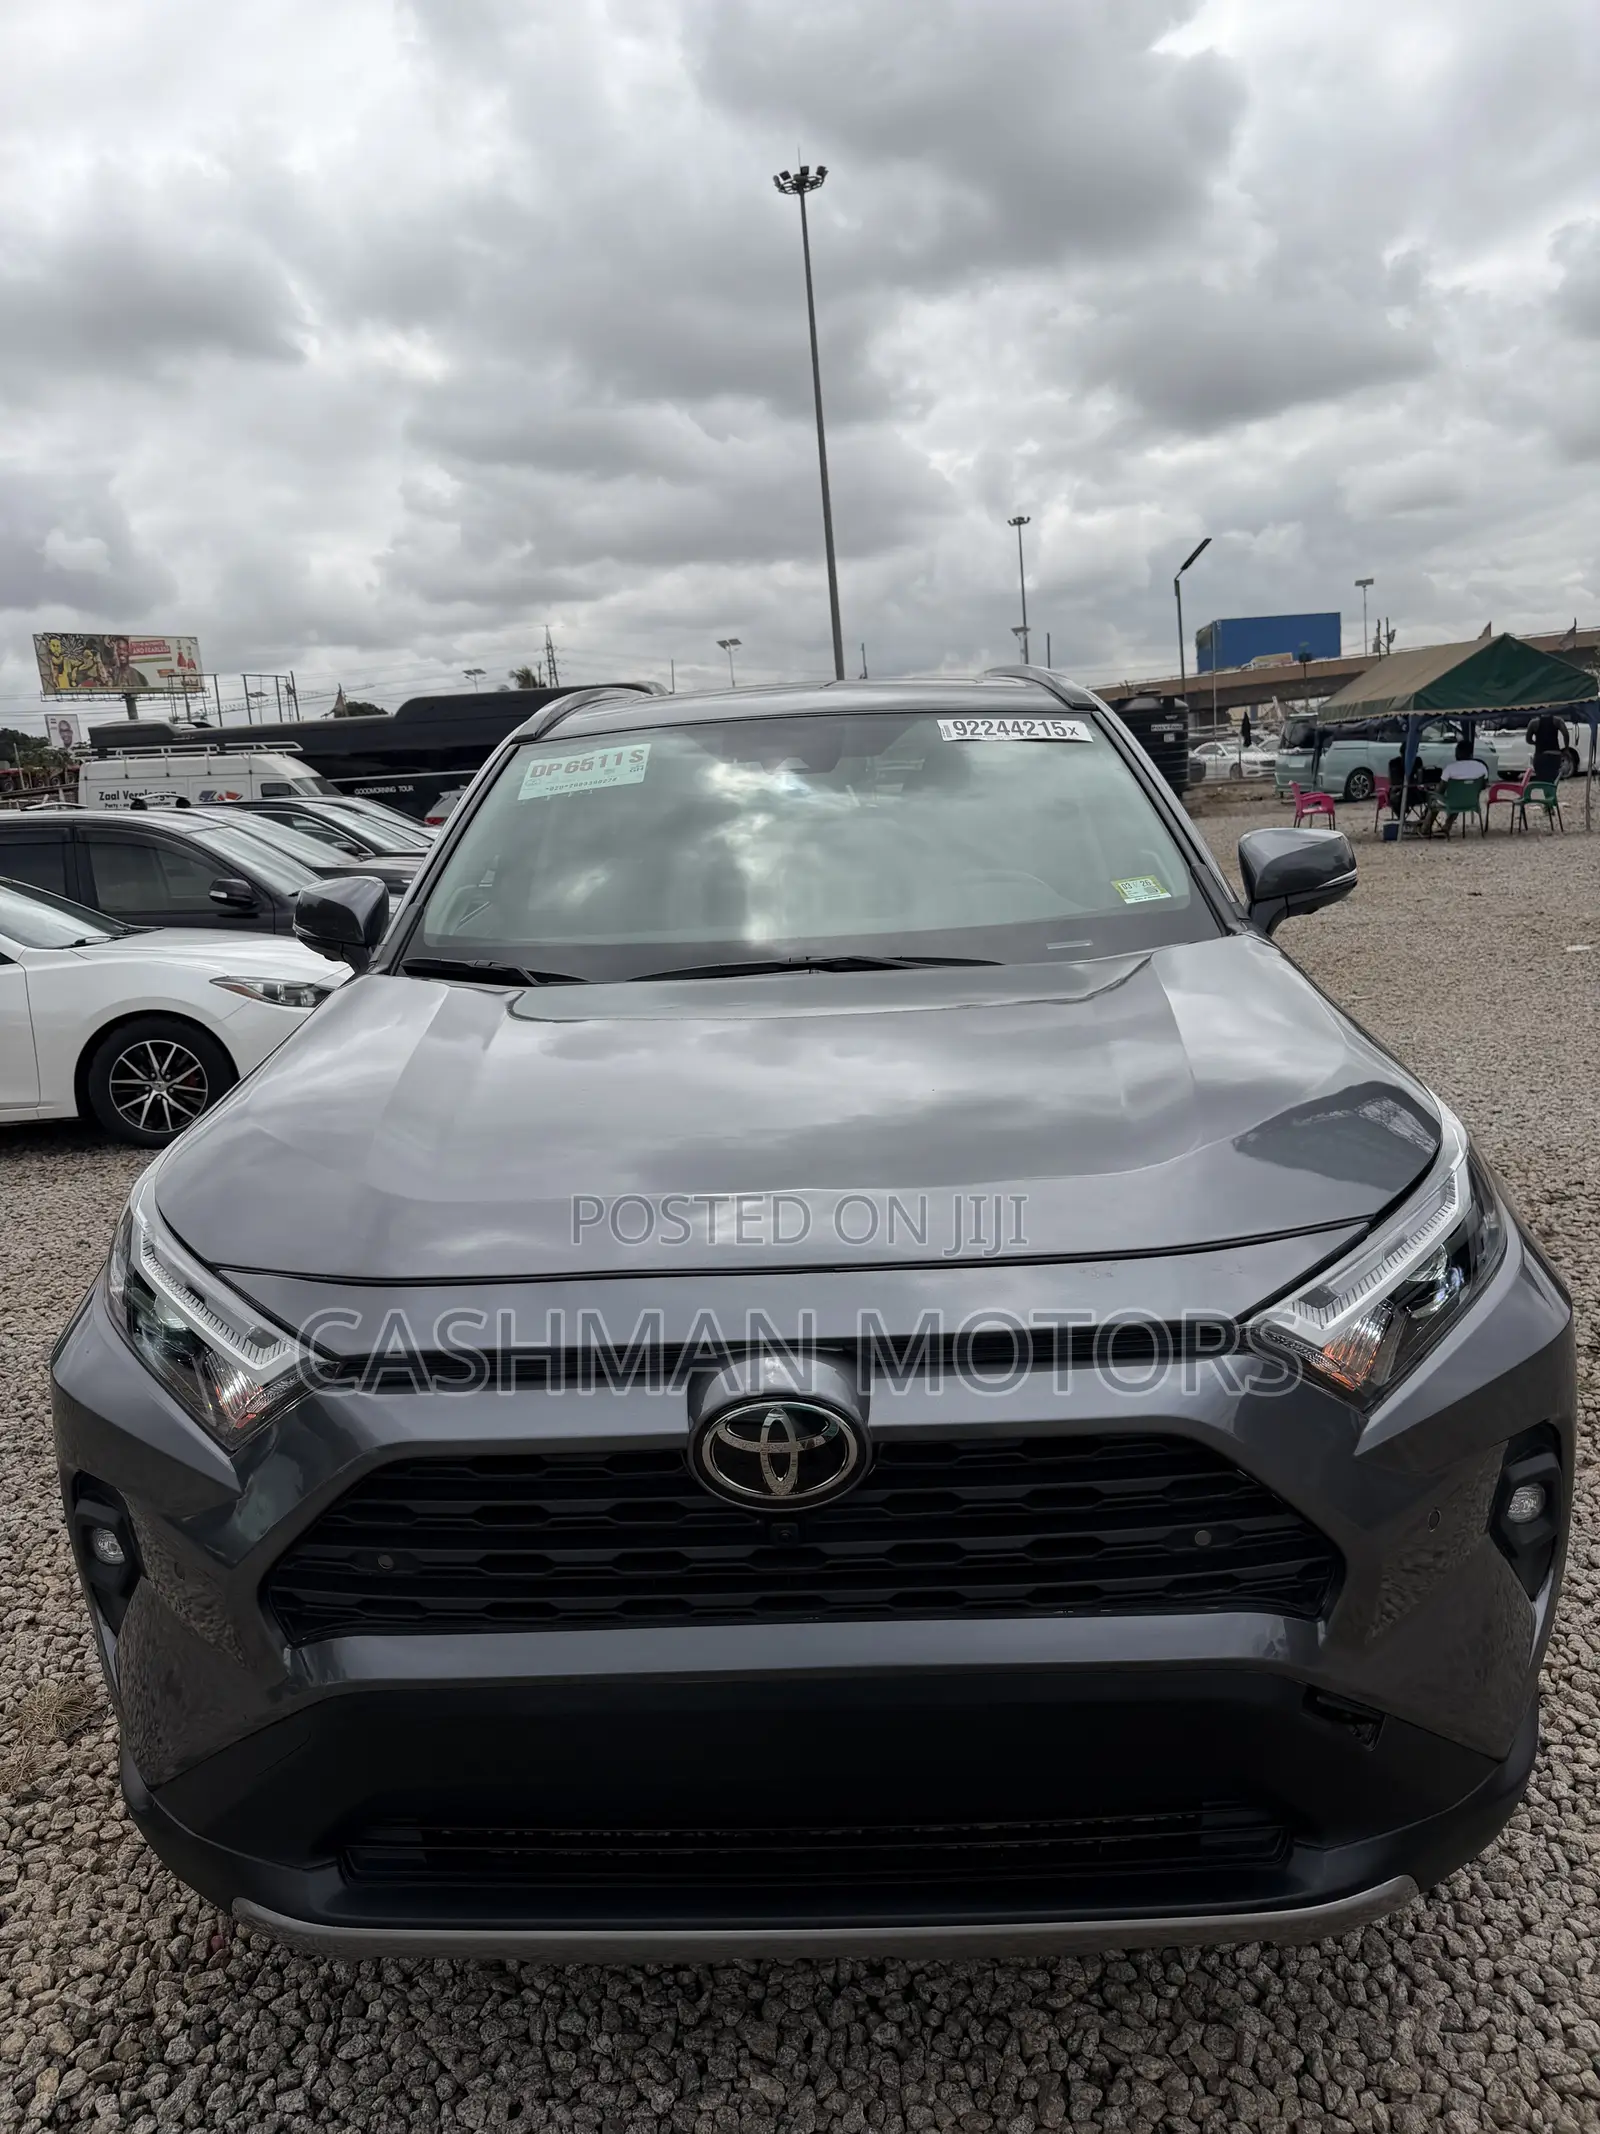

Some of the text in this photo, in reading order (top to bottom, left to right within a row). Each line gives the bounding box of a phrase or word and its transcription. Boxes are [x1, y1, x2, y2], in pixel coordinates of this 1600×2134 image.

[530, 763, 562, 778] DP
[564, 752, 623, 774] 6511
[629, 749, 644, 763] S
[99, 790, 120, 801] Zaal
